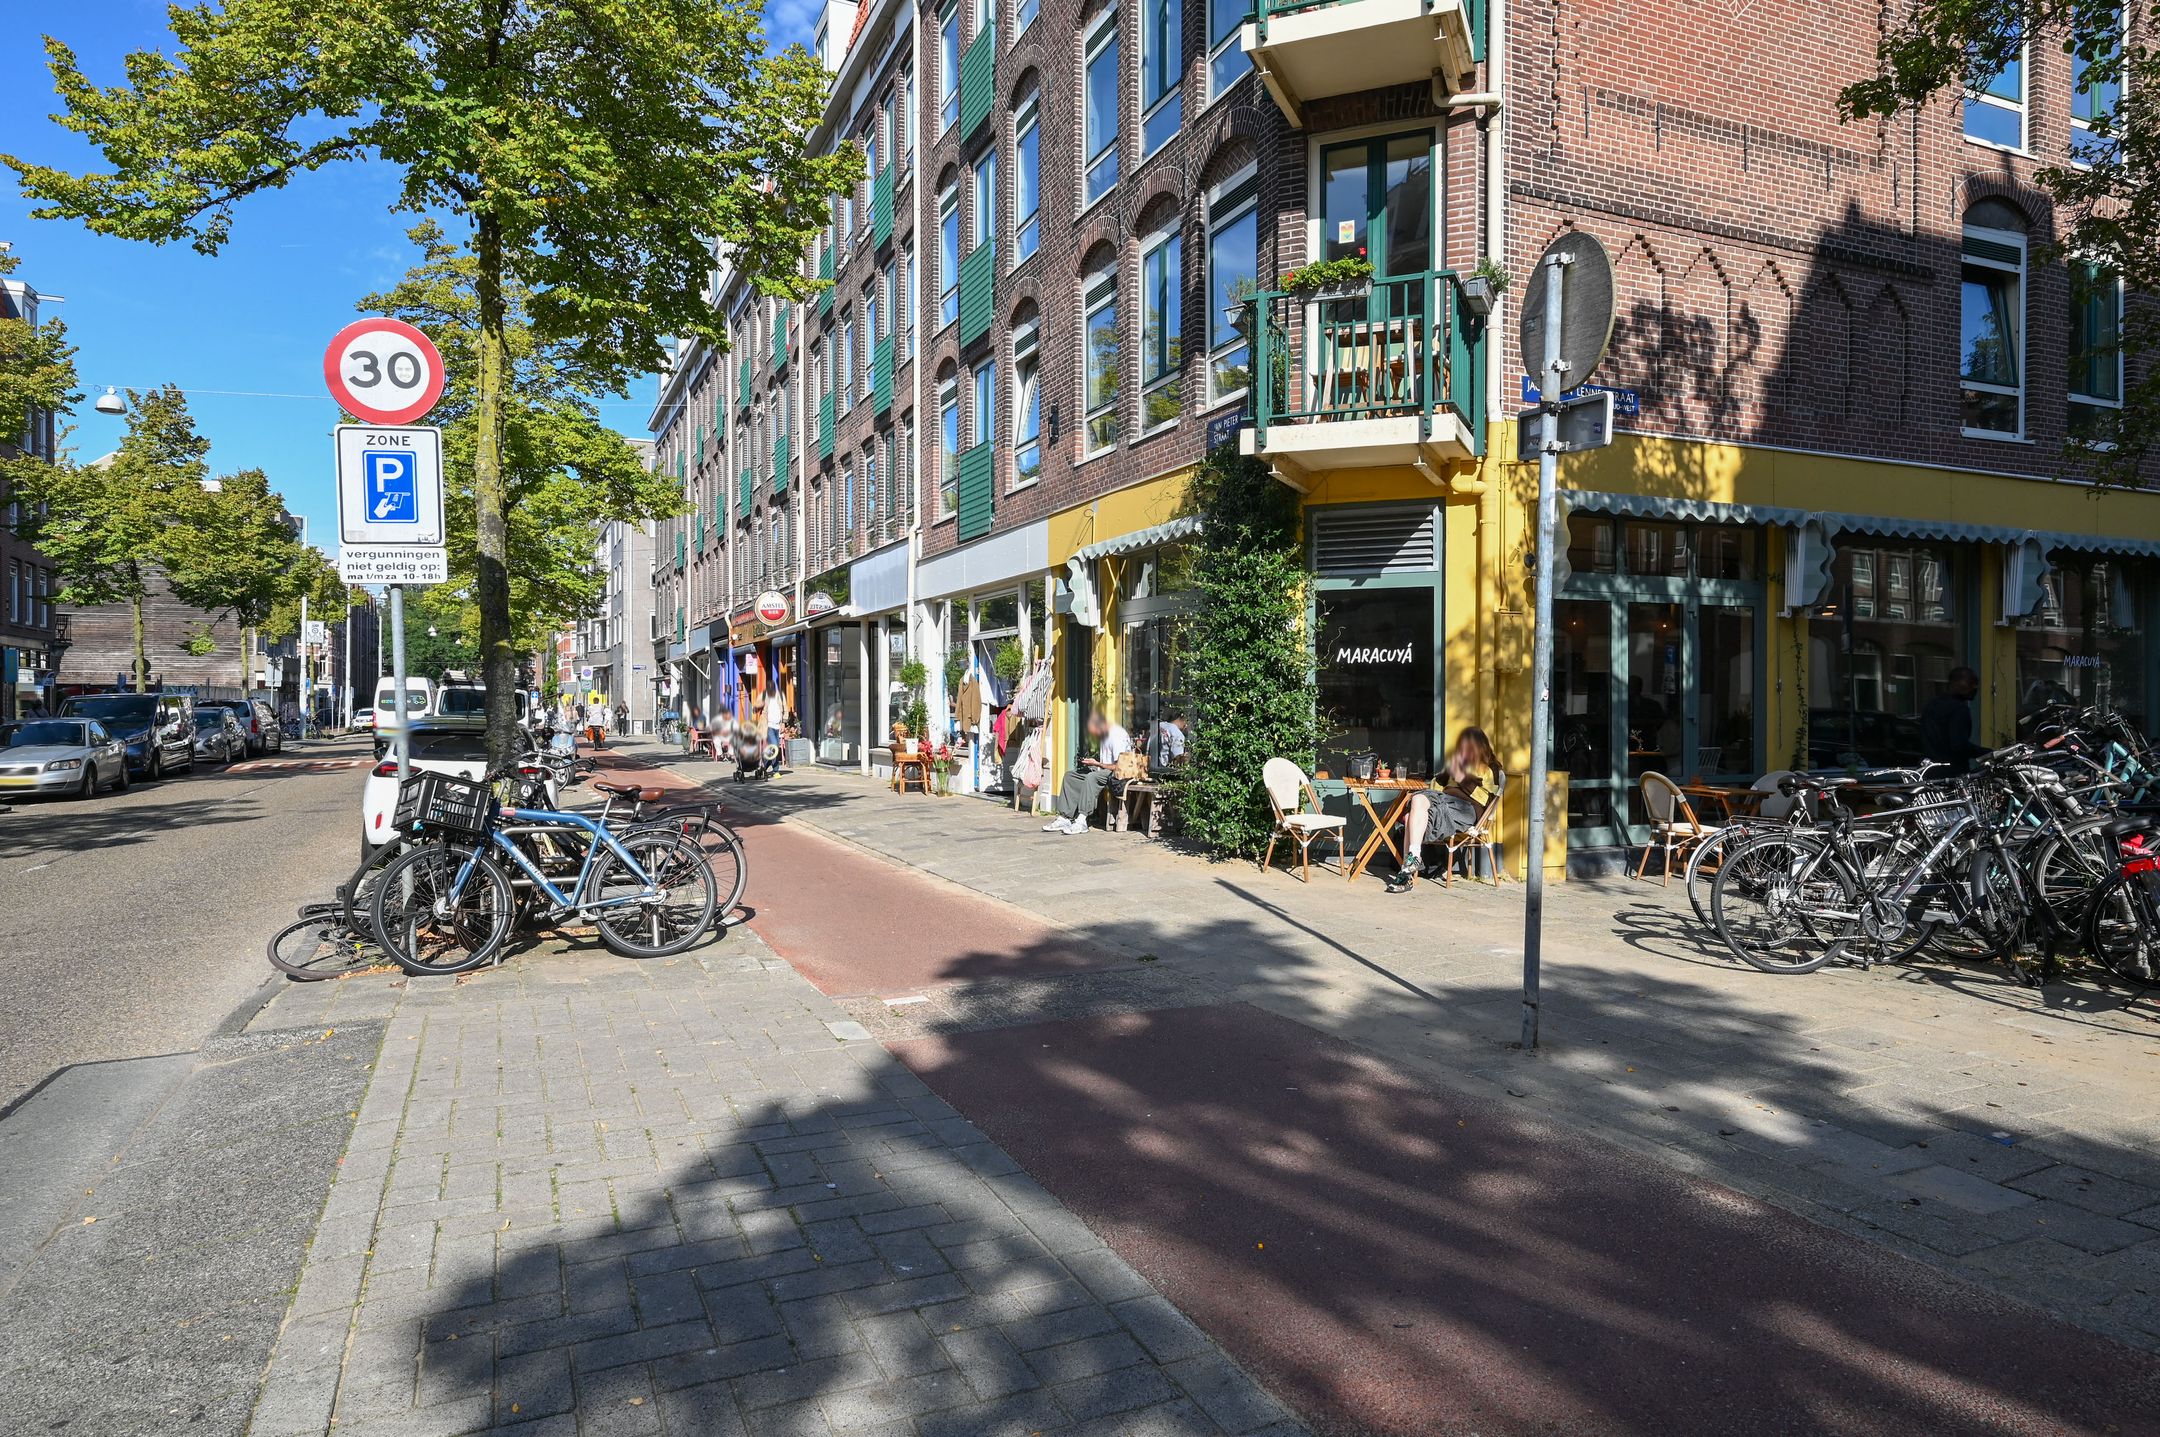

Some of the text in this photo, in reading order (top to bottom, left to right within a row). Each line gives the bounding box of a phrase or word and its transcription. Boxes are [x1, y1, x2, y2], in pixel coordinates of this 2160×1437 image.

[348, 350, 421, 389] 30
[1223, 415, 1238, 428] PIETER
[366, 434, 411, 447] ZONE
[375, 457, 404, 493] P
[346, 550, 440, 560] vergunningen
[347, 562, 440, 572] niet geldig op:
[1336, 642, 1412, 664] MARACUYÁ
[2063, 651, 2100, 668] MARACUYÁ
[1918, 836, 1949, 868] TREK
